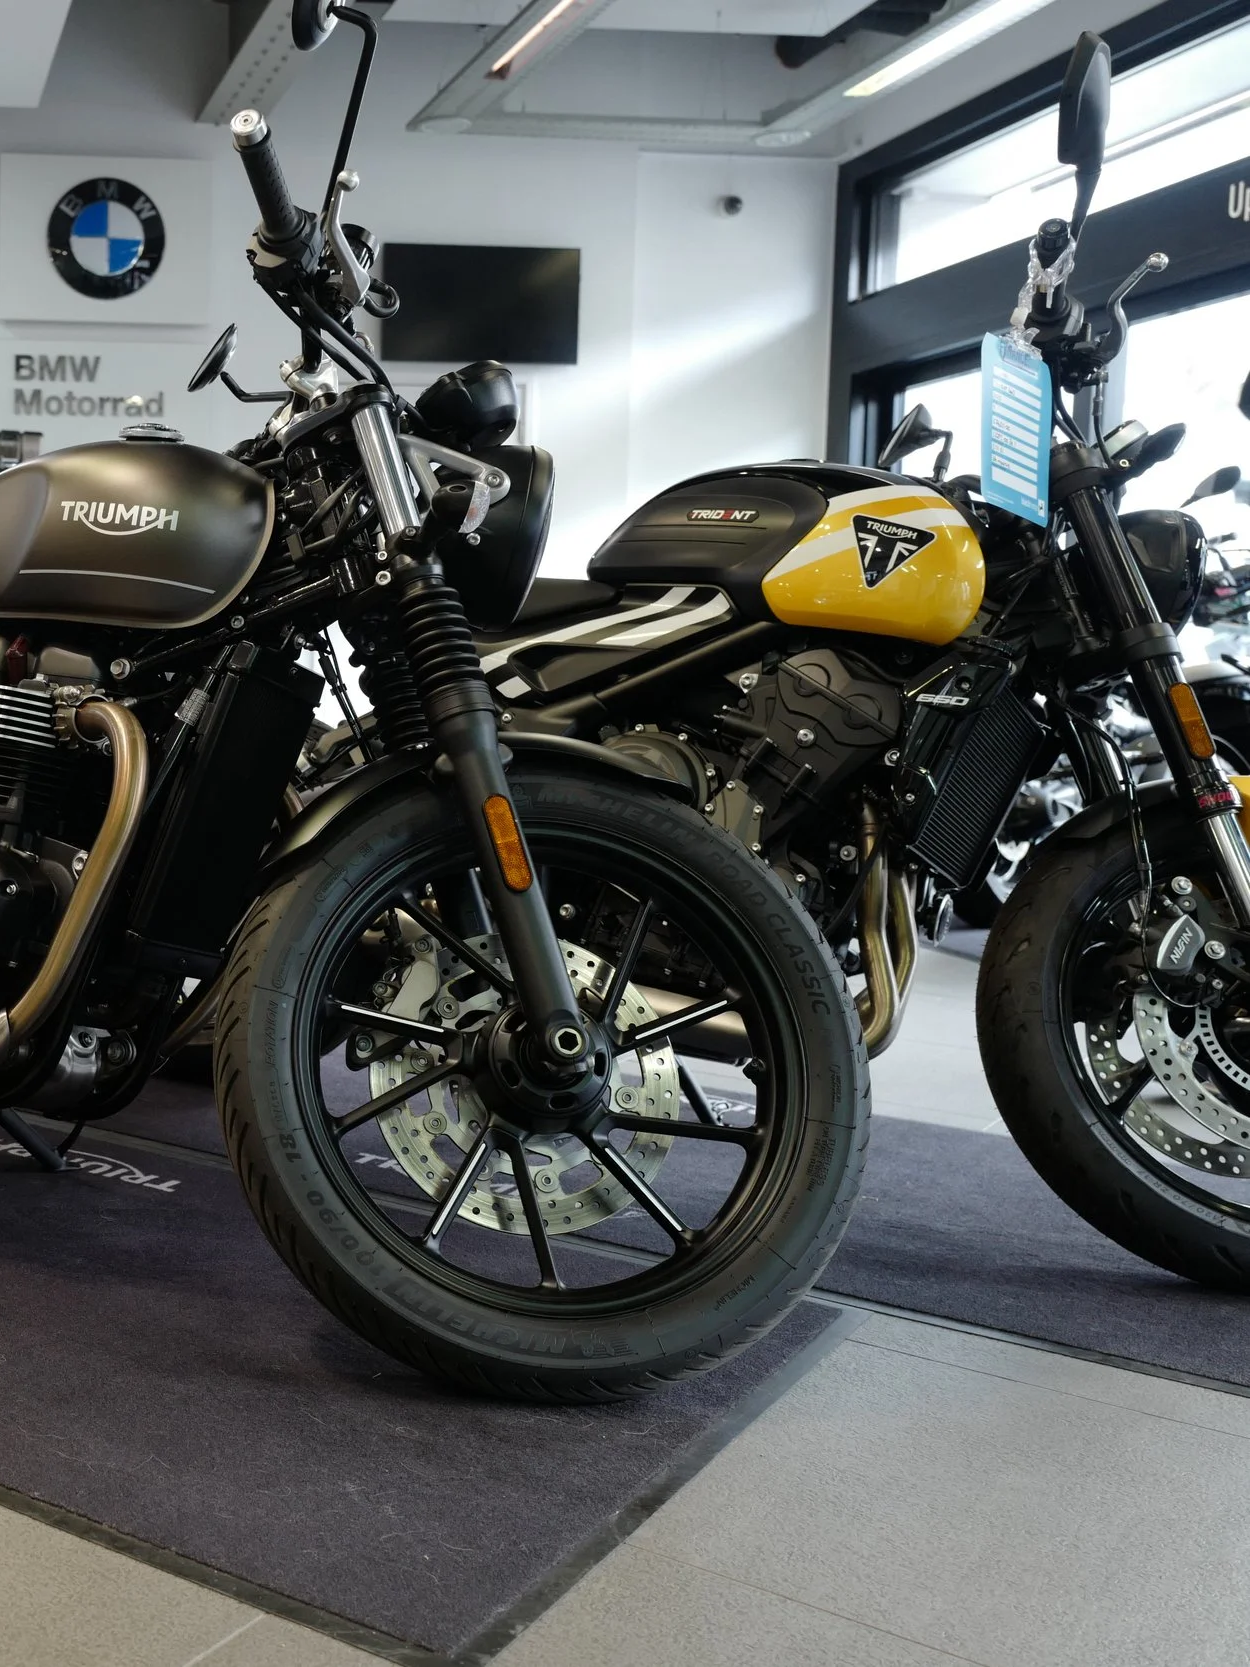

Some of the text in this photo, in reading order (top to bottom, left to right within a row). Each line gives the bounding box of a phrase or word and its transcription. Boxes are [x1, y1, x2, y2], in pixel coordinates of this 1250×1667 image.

[59, 181, 156, 221] BMW
[14, 354, 101, 383] BMW
[13, 388, 165, 418] Motorrad
[60, 500, 180, 535] TRIUMPH
[690, 508, 758, 521] TRIDENT
[865, 519, 919, 541] TRIUMPH
[915, 693, 970, 706] 660
[537, 784, 700, 846] MICHELIN
[706, 850, 832, 1017] ROAD CLASSIC
[1170, 926, 1194, 965] NISSIN
[278, 1133, 302, 1164] 18
[1153, 1180, 1170, 1194] ZR
[1171, 1193, 1221, 1223] 120/70
[389, 1277, 567, 1355] MICHELIN
